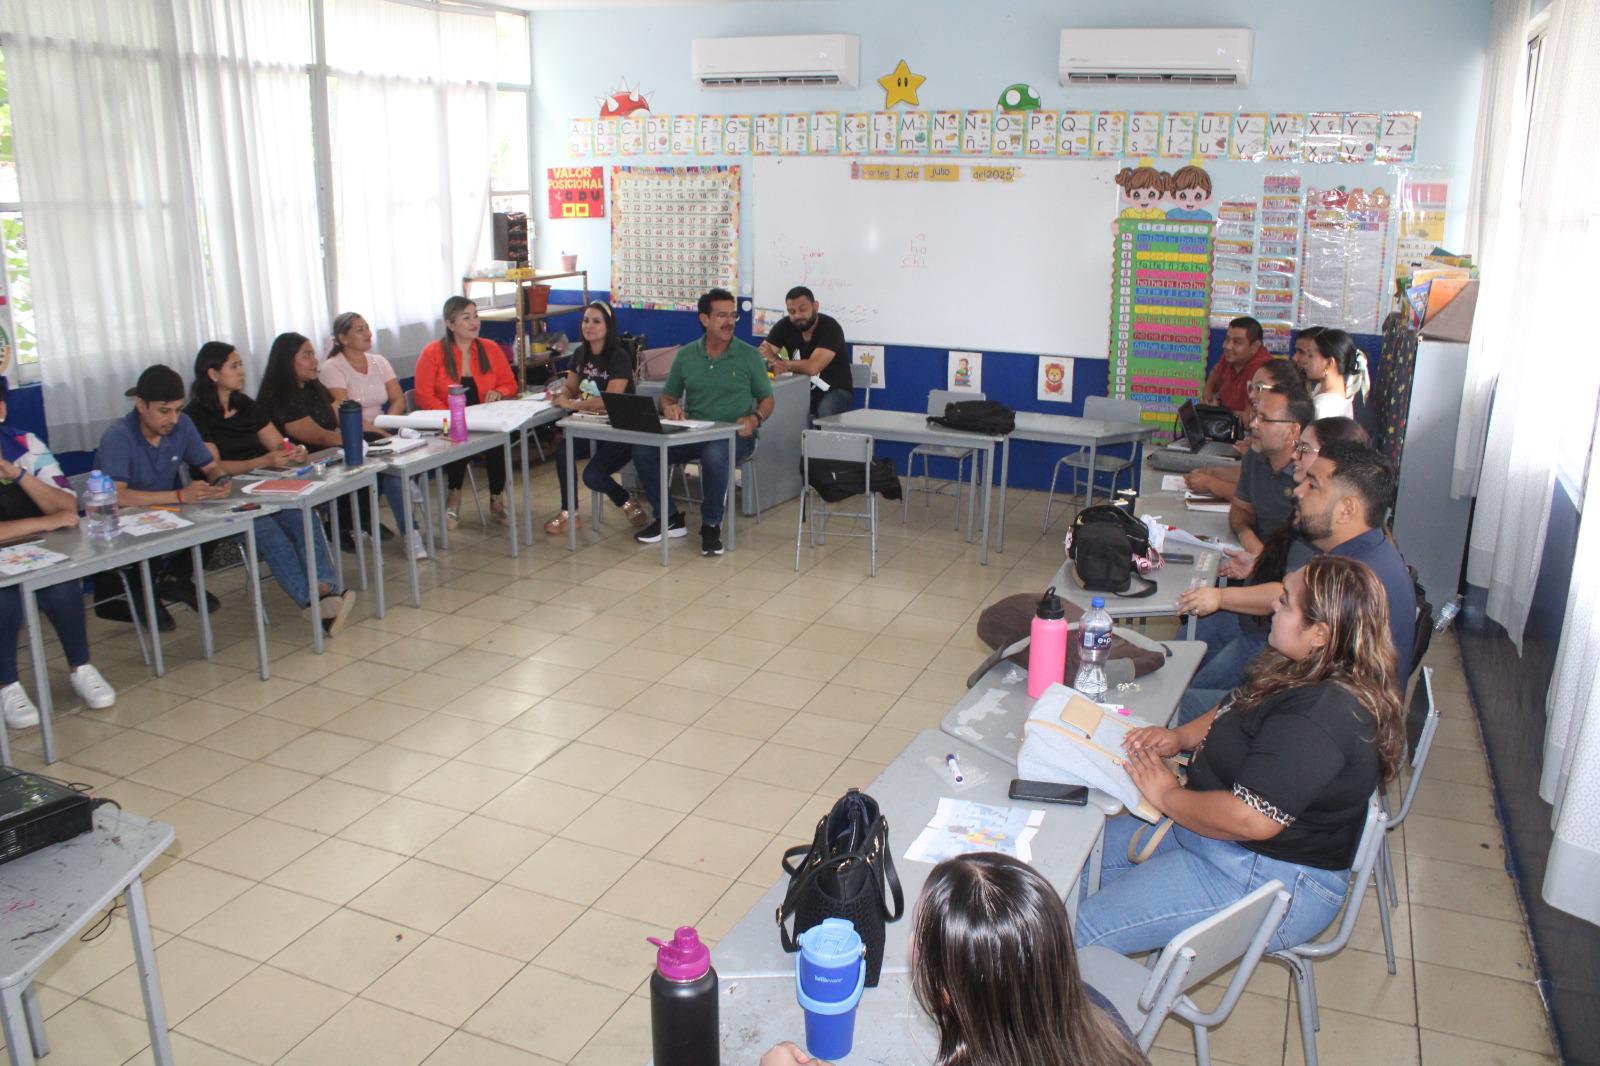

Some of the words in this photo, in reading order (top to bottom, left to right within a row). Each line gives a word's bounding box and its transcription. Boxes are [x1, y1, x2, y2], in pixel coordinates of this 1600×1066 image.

[571, 125, 580, 135] A
[597, 122, 605, 135] B
[621, 122, 631, 135] C
[647, 121, 657, 134] D
[673, 121, 681, 134] E
[701, 120, 708, 133] F
[726, 121, 738, 133] G
[755, 120, 765, 133] H
[812, 117, 819, 131] J
[844, 119, 853, 133] K
[873, 117, 880, 131] L
[901, 117, 915, 131] M
[934, 117, 945, 130] N
[995, 117, 1010, 132] O
[1031, 116, 1041, 131] P
[1061, 117, 1076, 133] Q
[1097, 117, 1108, 132] R
[1132, 118, 1140, 133] S
[1168, 118, 1175, 133] T
[1201, 119, 1212, 134] U
[1236, 119, 1249, 134] V
[1270, 120, 1288, 135] W
[1309, 120, 1320, 135] X
[1347, 120, 1359, 135] Y
[1385, 119, 1395, 136] Z
[571, 143, 579, 153] a
[597, 140, 605, 152] b
[622, 142, 630, 151] c
[648, 136, 656, 151] d
[674, 141, 682, 151] e
[702, 136, 707, 151] f
[756, 135, 764, 151] h
[845, 135, 852, 151] k
[900, 139, 914, 149] m
[934, 138, 943, 149] n
[966, 135, 975, 149] ñ
[997, 140, 1007, 150] o
[1030, 139, 1040, 152] p
[1061, 140, 1072, 155] q
[1097, 140, 1103, 151] r
[1131, 142, 1138, 152] s
[1167, 135, 1173, 152] t
[1199, 143, 1209, 153] u
[1236, 144, 1246, 154] v
[1270, 145, 1285, 155] w
[1309, 146, 1317, 156] x
[552, 167, 592, 179] VALOR
[863, 168, 890, 177] artes
[906, 169, 919, 179] de
[930, 165, 950, 178] julio
[547, 178, 604, 190] POSICIONAL
[590, 190, 600, 202] U
[1152, 279, 1162, 287] he
[1180, 280, 1190, 289] ho
[1194, 281, 1204, 289] hu
